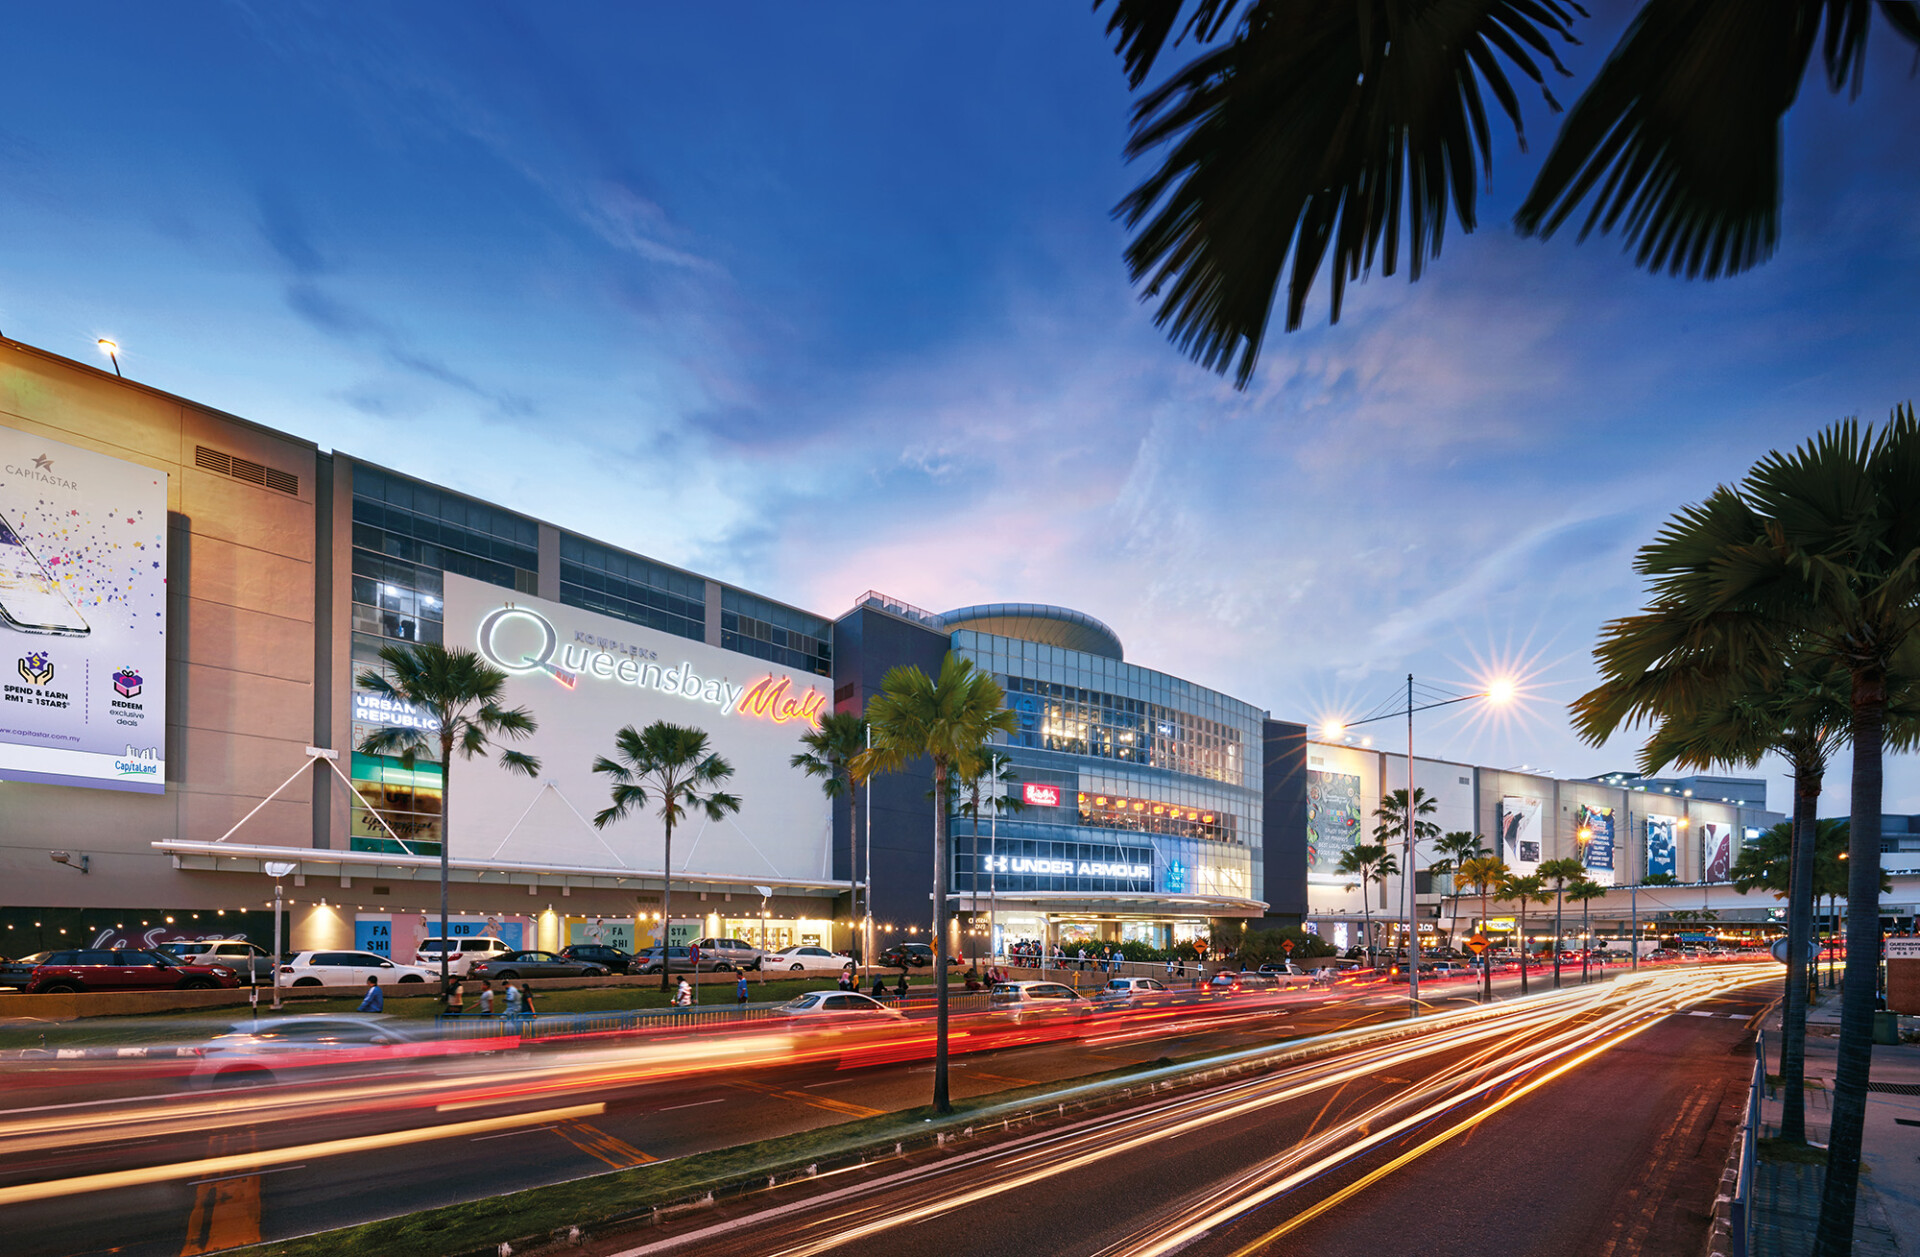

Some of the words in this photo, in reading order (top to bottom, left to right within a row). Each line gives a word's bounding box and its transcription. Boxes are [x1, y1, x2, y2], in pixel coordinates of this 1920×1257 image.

[5, 464, 78, 491] CAPITASTAR
[574, 630, 658, 661] KOMPLEKS
[477, 607, 744, 716] Queensbay
[738, 676, 827, 728] Mall
[4, 685, 33, 695] SPEND
[45, 690, 68, 700] EARN
[5, 694, 24, 702] RM1
[112, 700, 143, 710] REDEEM
[356, 695, 417, 715] URBAN
[109, 709, 145, 719] exclusive
[356, 708, 439, 730] REPUBLIC
[116, 719, 138, 727] deals
[115, 761, 157, 774] CapitaLand
[1012, 858, 1074, 874] UNDER
[1077, 861, 1150, 879] ARMOUR
[373, 925, 388, 936] FA
[455, 925, 470, 935] OB
[612, 927, 623, 936] FA
[671, 927, 687, 936] STA
[367, 940, 389, 951] SHI
[612, 939, 628, 948] SHI
[671, 939, 681, 947] TE
